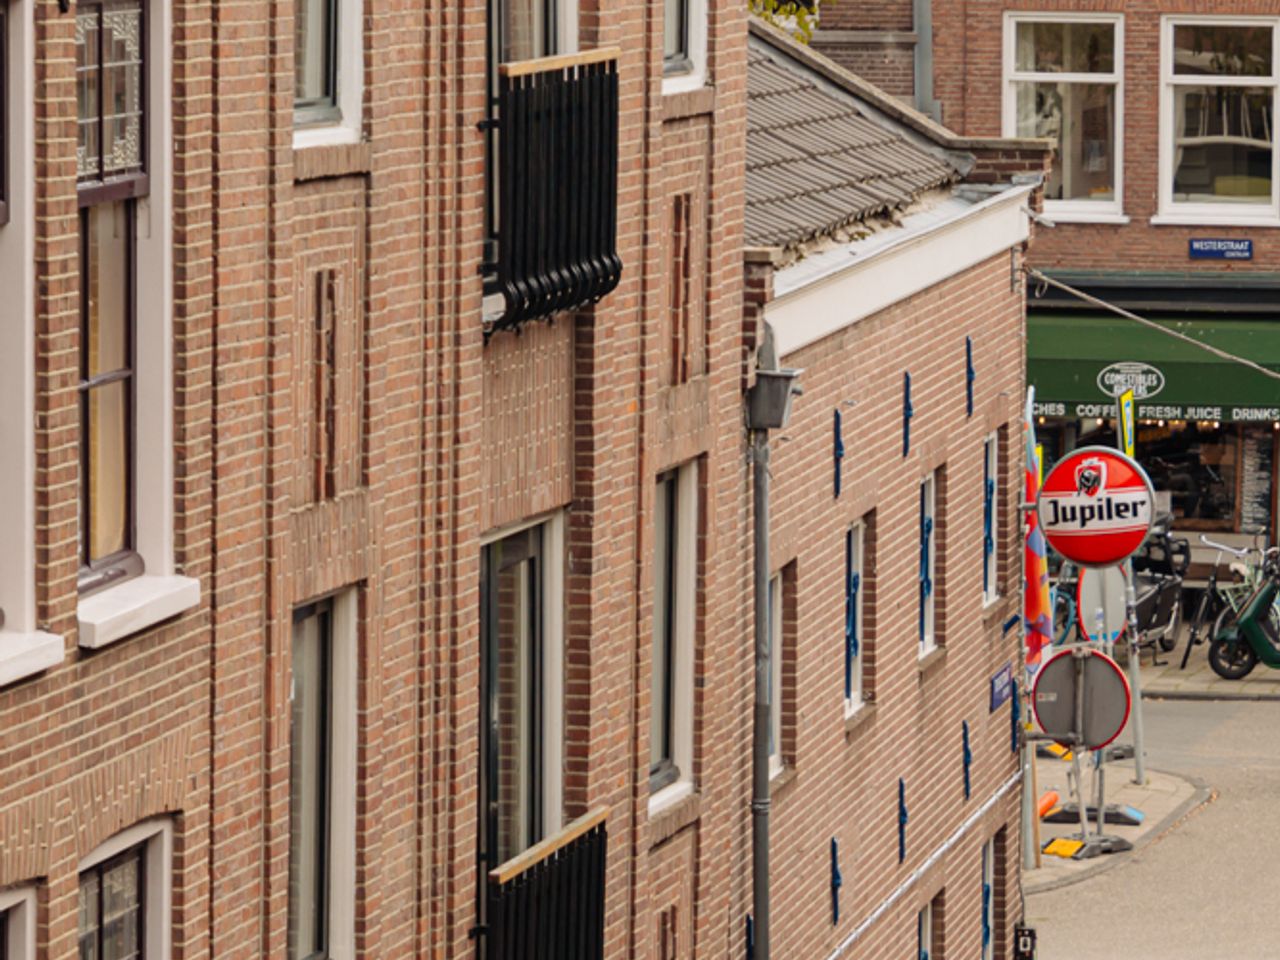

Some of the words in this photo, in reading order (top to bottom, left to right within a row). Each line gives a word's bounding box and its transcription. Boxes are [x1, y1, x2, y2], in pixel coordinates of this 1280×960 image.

[1192, 240, 1250, 250] WESTERSTRAAT
[1031, 401, 1066, 416] CHES
[1075, 403, 1118, 418] COFFE
[1138, 405, 1182, 419] FRESH
[1184, 406, 1223, 420] JUICE
[1231, 407, 1280, 421] DRINKS
[1046, 497, 1147, 529] Jupiler
